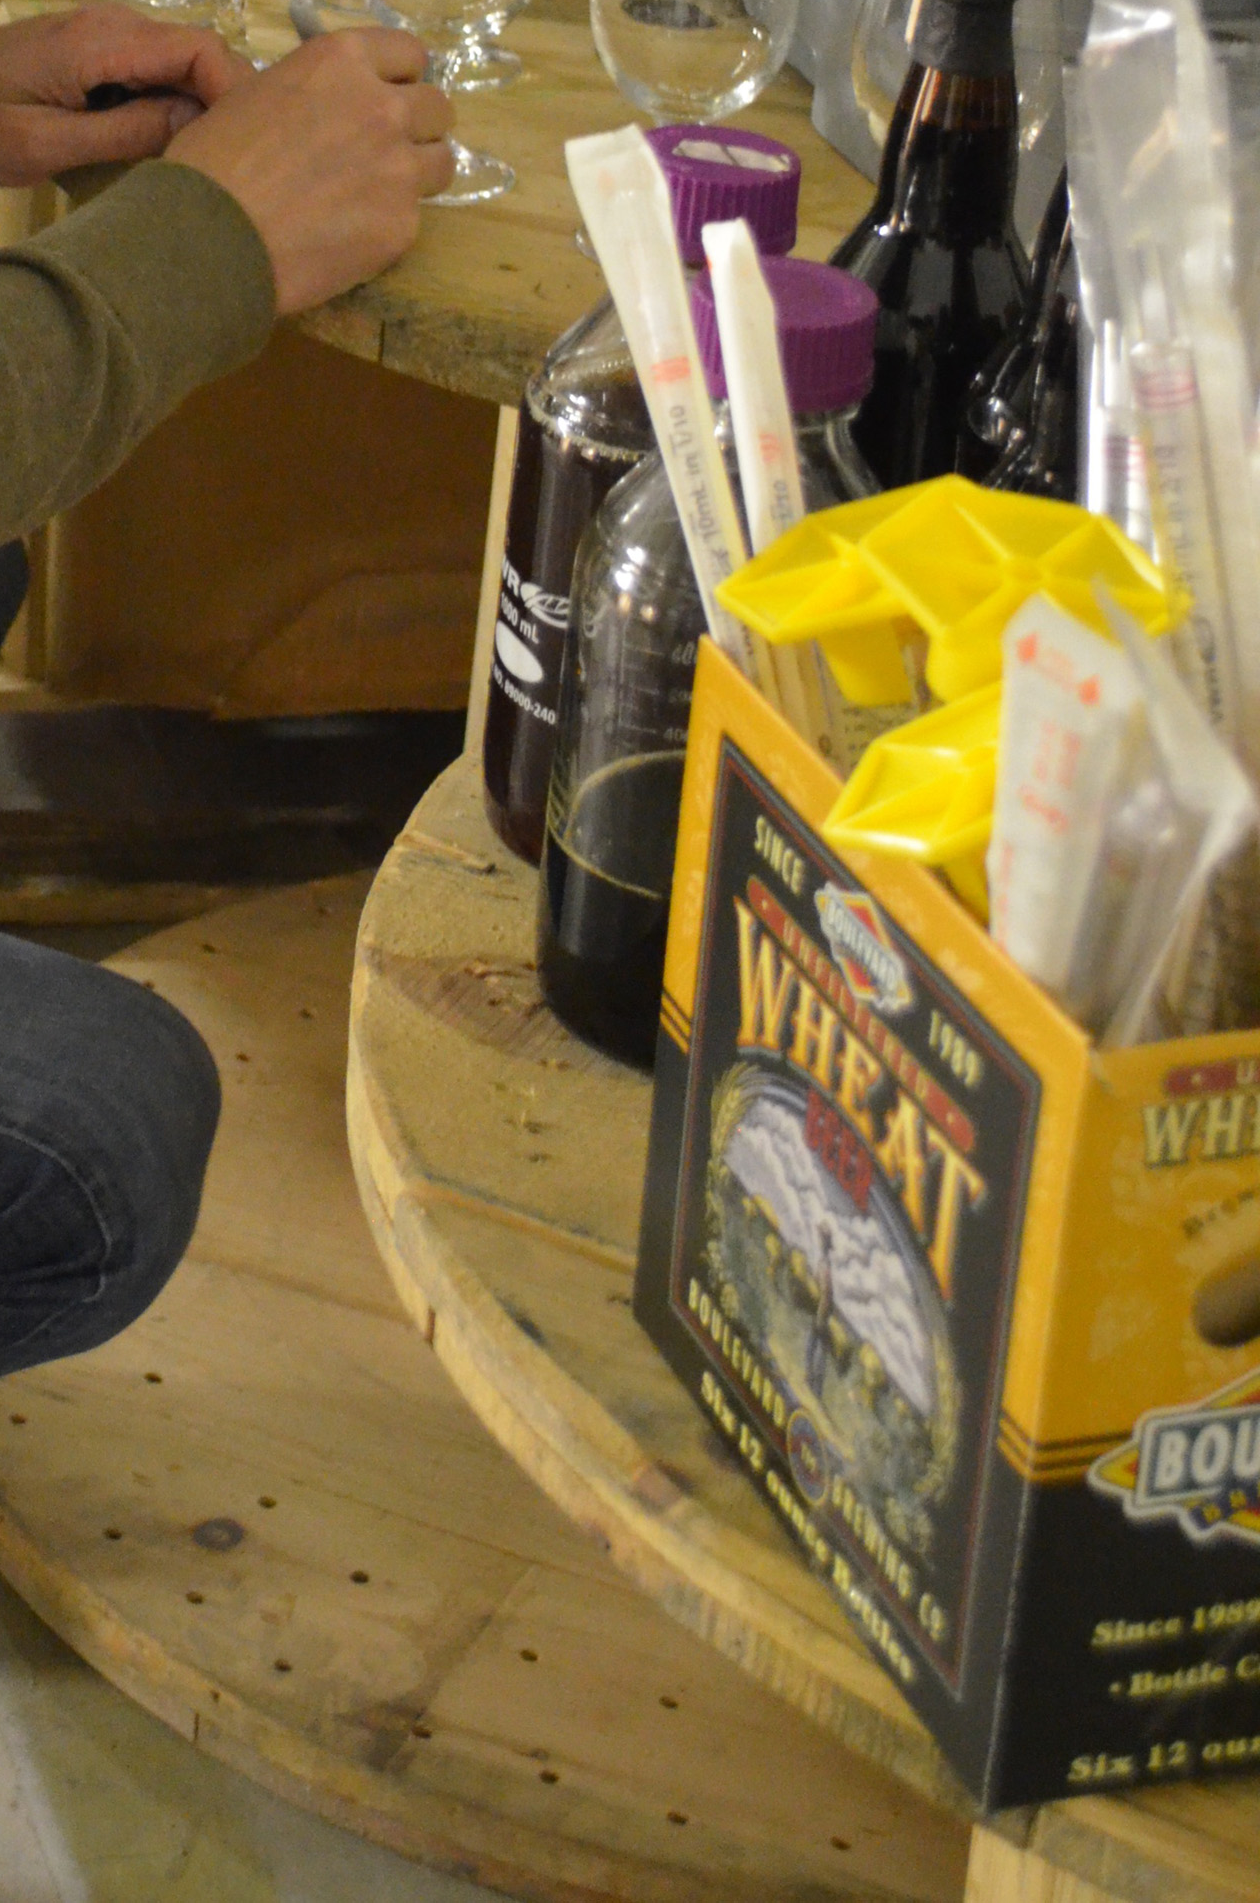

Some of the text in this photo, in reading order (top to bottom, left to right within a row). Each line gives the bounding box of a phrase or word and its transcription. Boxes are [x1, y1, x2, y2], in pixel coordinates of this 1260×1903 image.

[520, 620, 539, 645] mL
[754, 815, 804, 895] SINCE
[734, 895, 989, 1303] WHEAT
[1143, 1093, 1260, 1165] WH
[688, 1278, 786, 1428] BOULEVARD
[1091, 1616, 1183, 1647] Since
[1128, 1660, 1228, 1697] Bottle
[1067, 1753, 1135, 1787] Six
[1148, 1740, 1189, 1772] 12
